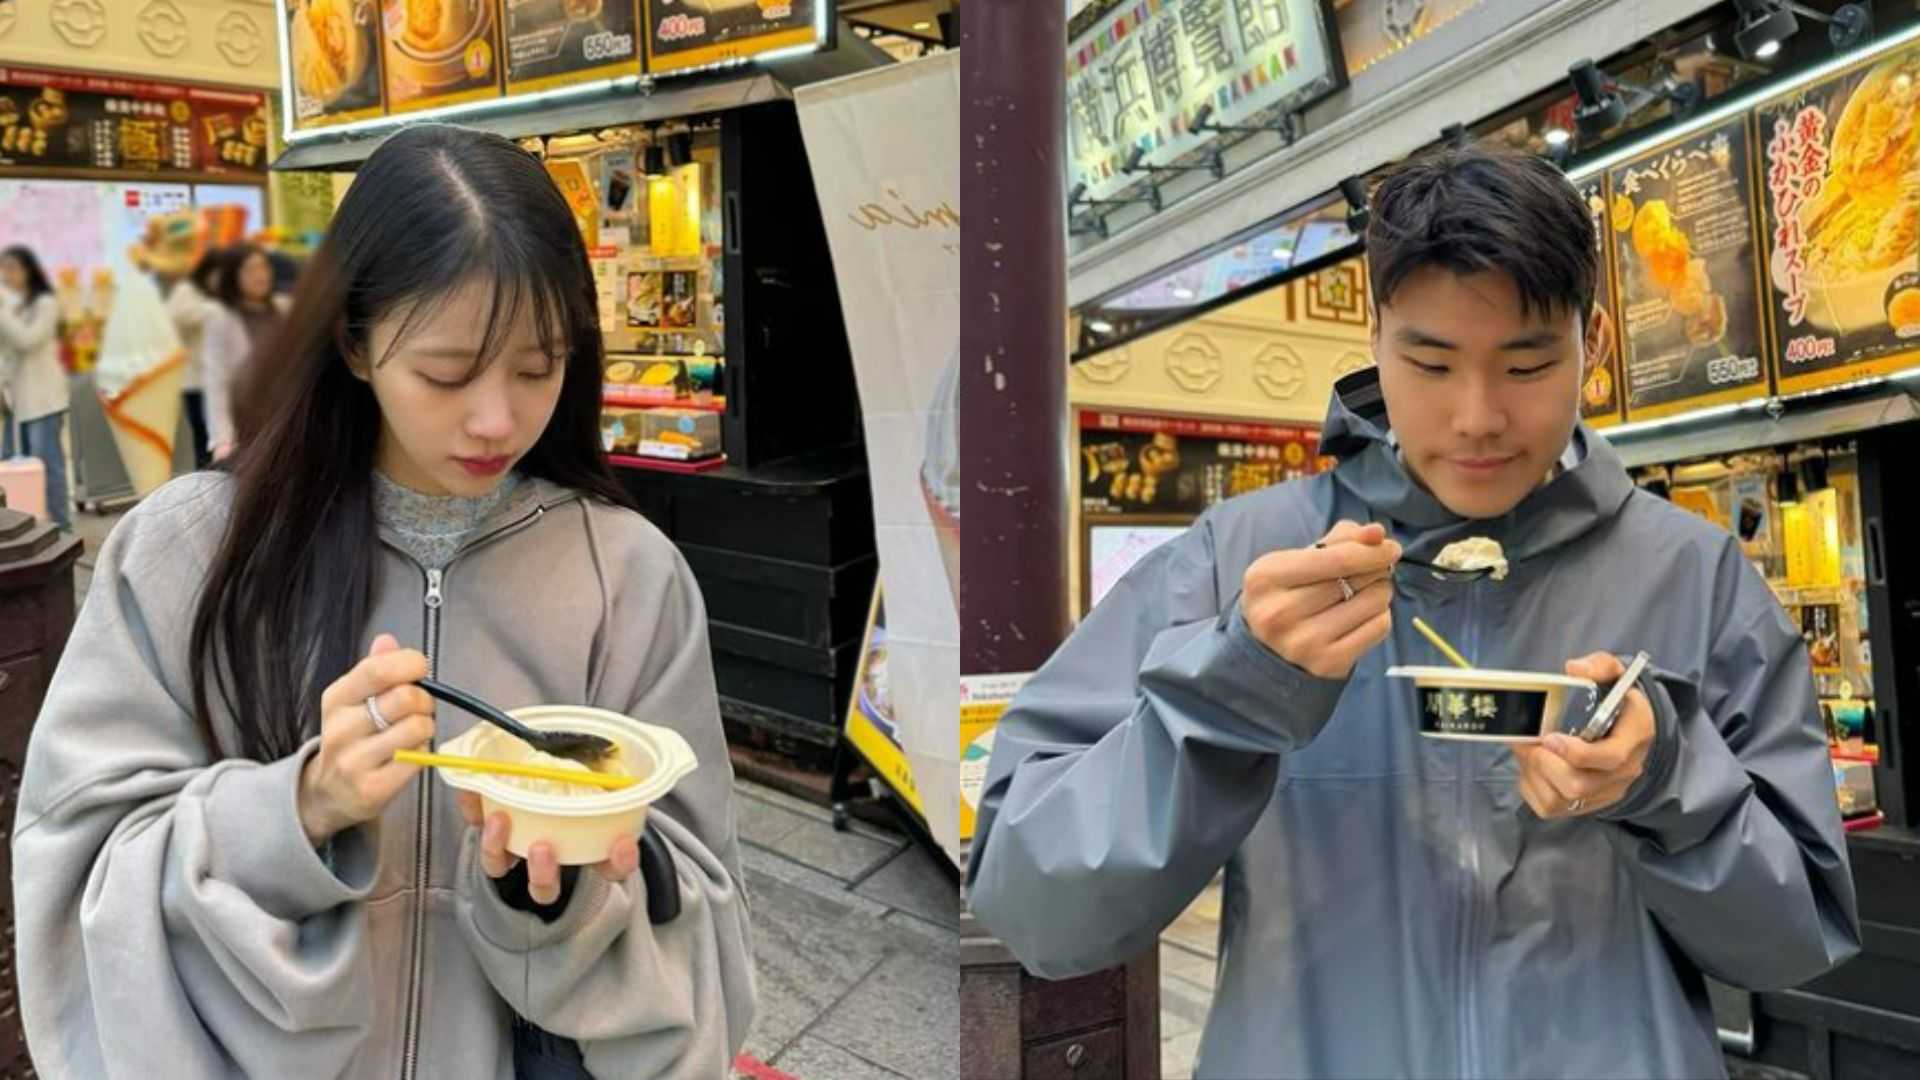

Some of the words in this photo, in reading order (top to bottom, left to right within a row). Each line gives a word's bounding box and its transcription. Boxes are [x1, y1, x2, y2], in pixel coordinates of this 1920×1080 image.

[1769, 120, 1807, 327] ふかひれスープ
[1798, 107, 1828, 198] 黄金の
